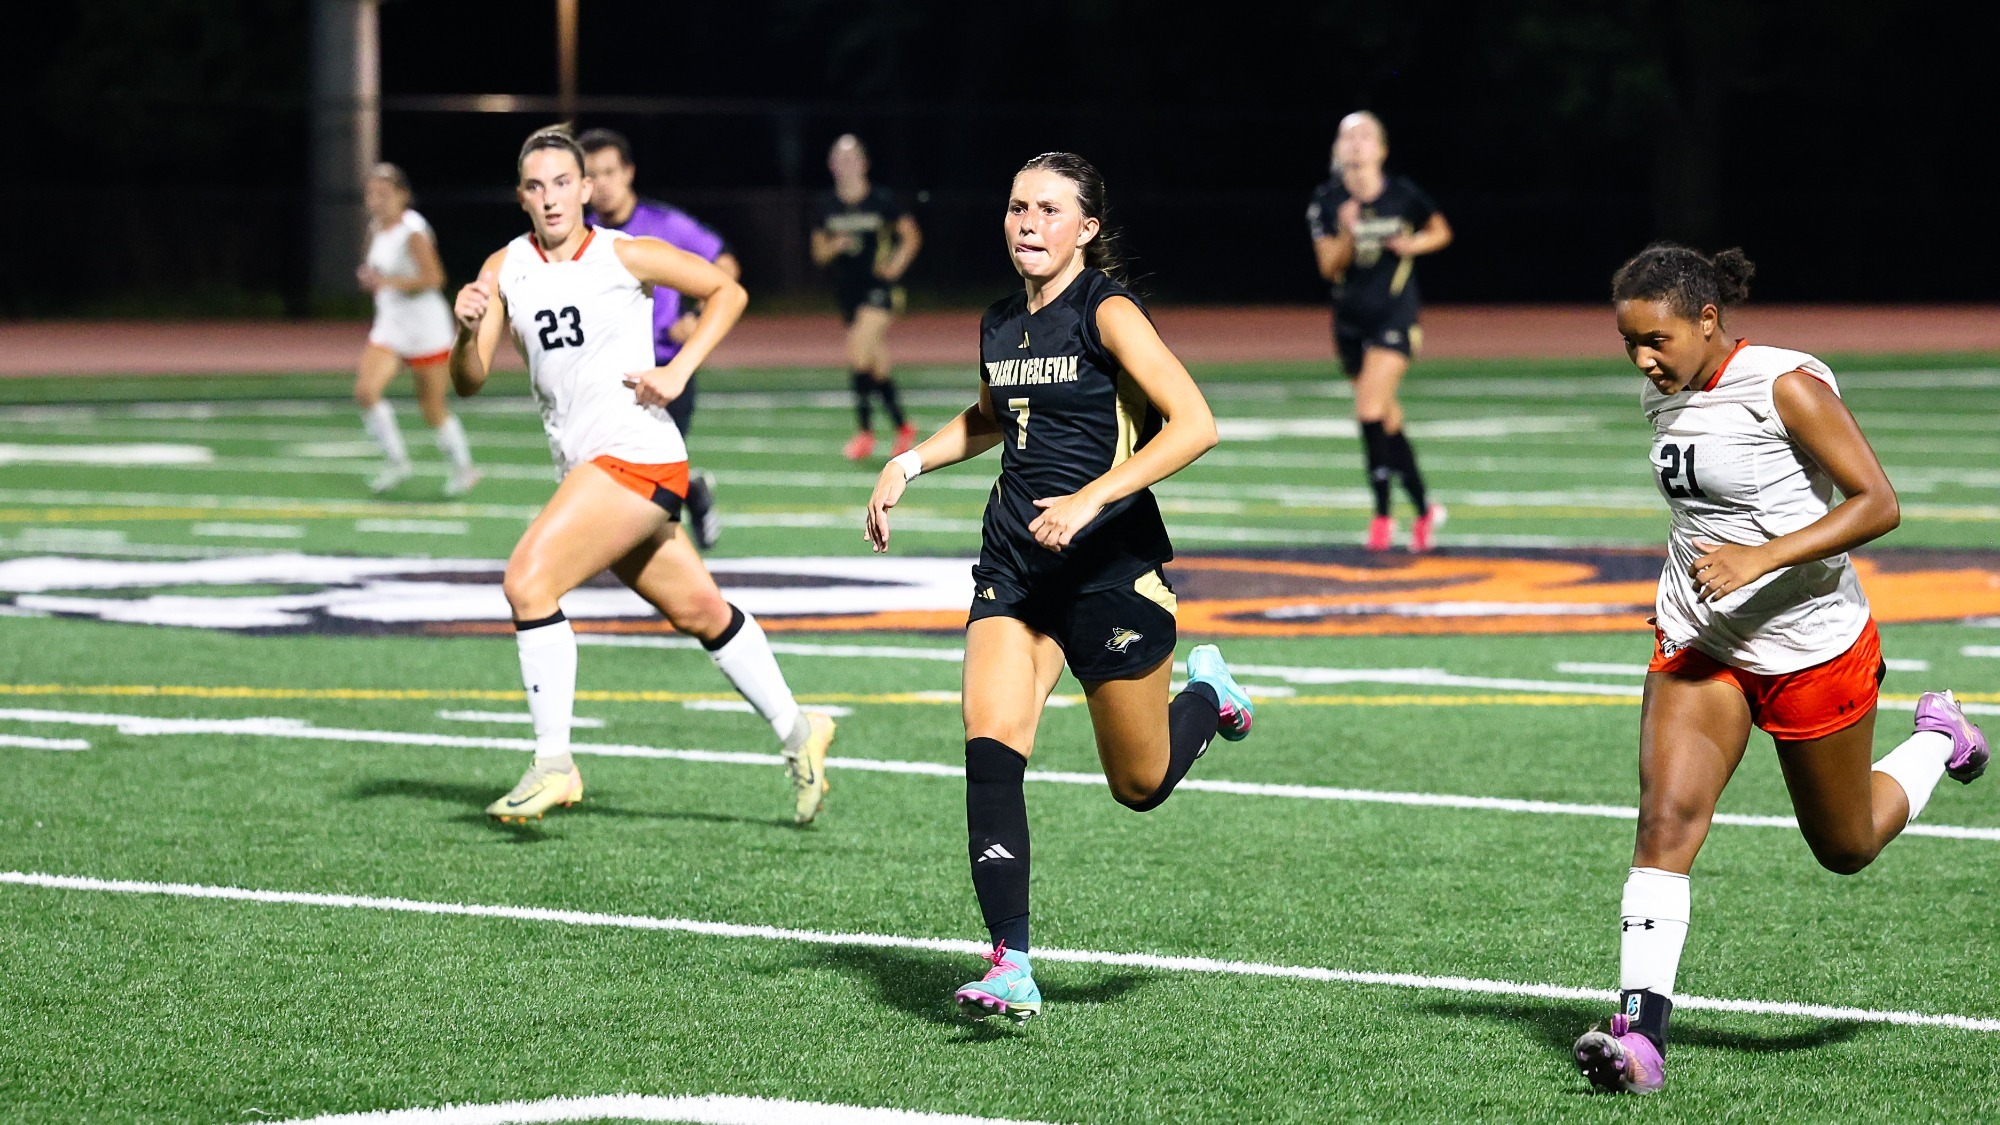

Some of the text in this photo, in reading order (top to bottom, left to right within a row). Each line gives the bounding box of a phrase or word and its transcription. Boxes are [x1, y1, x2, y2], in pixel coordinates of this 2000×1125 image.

[534, 305, 585, 351] 23
[1019, 355, 1079, 385] WESLEYAN
[1008, 397, 1030, 450] 7
[1660, 443, 1708, 499] 21
